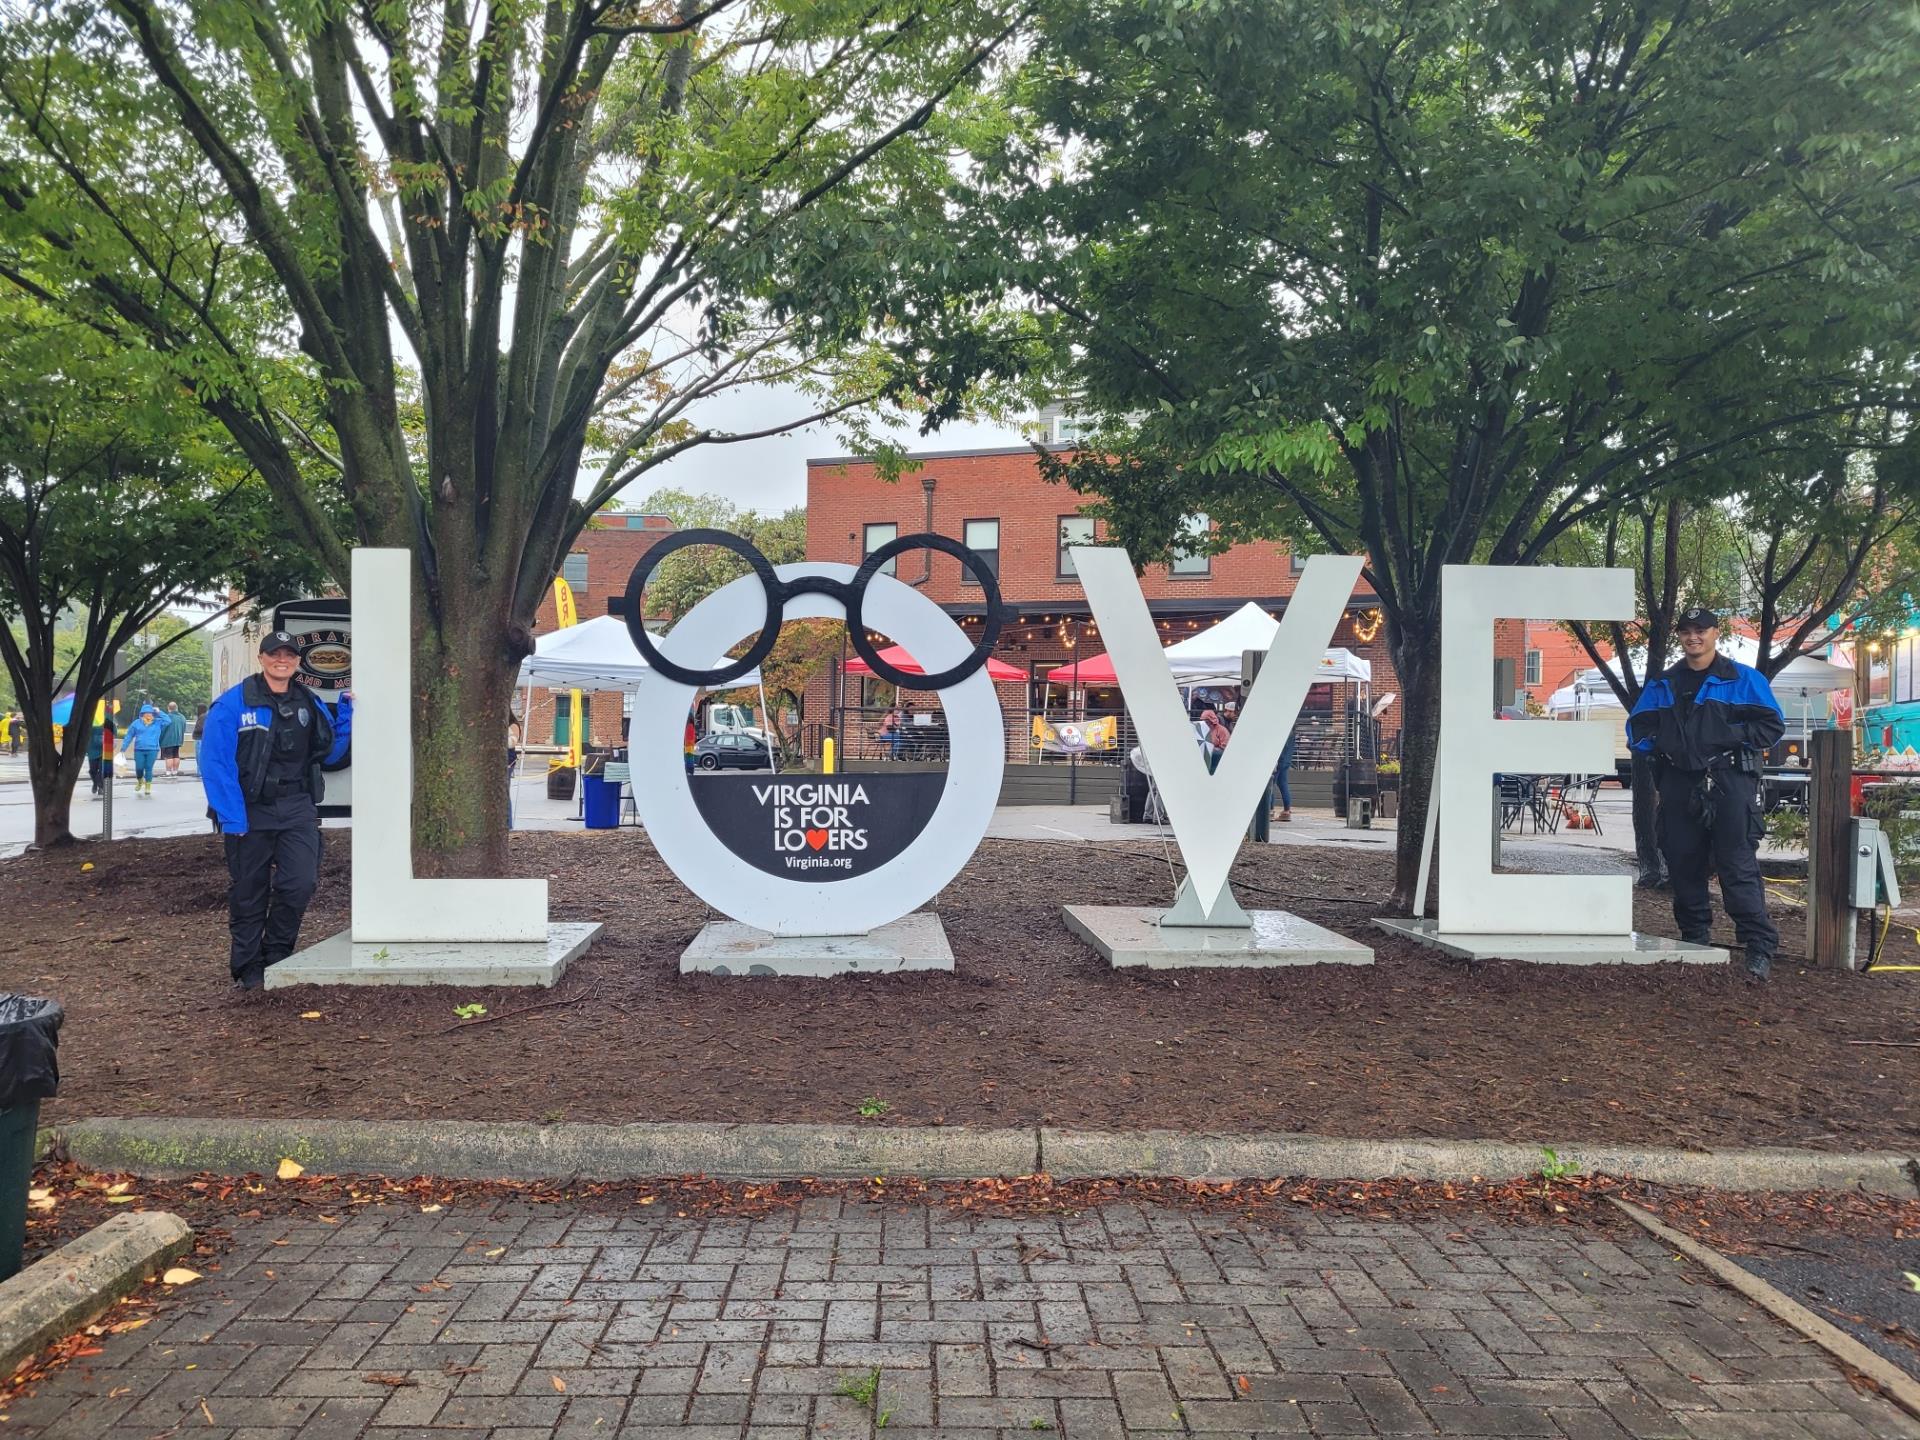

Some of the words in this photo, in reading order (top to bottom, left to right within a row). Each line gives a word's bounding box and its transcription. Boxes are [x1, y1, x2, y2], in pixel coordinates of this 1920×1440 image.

[295, 673, 322, 687] AND
[351, 546, 1636, 944] LOVE
[751, 783, 871, 806] VIRGINIA
[774, 807, 793, 829] IS
[800, 806, 854, 829] FOR
[785, 856, 853, 870] Virginia.org
